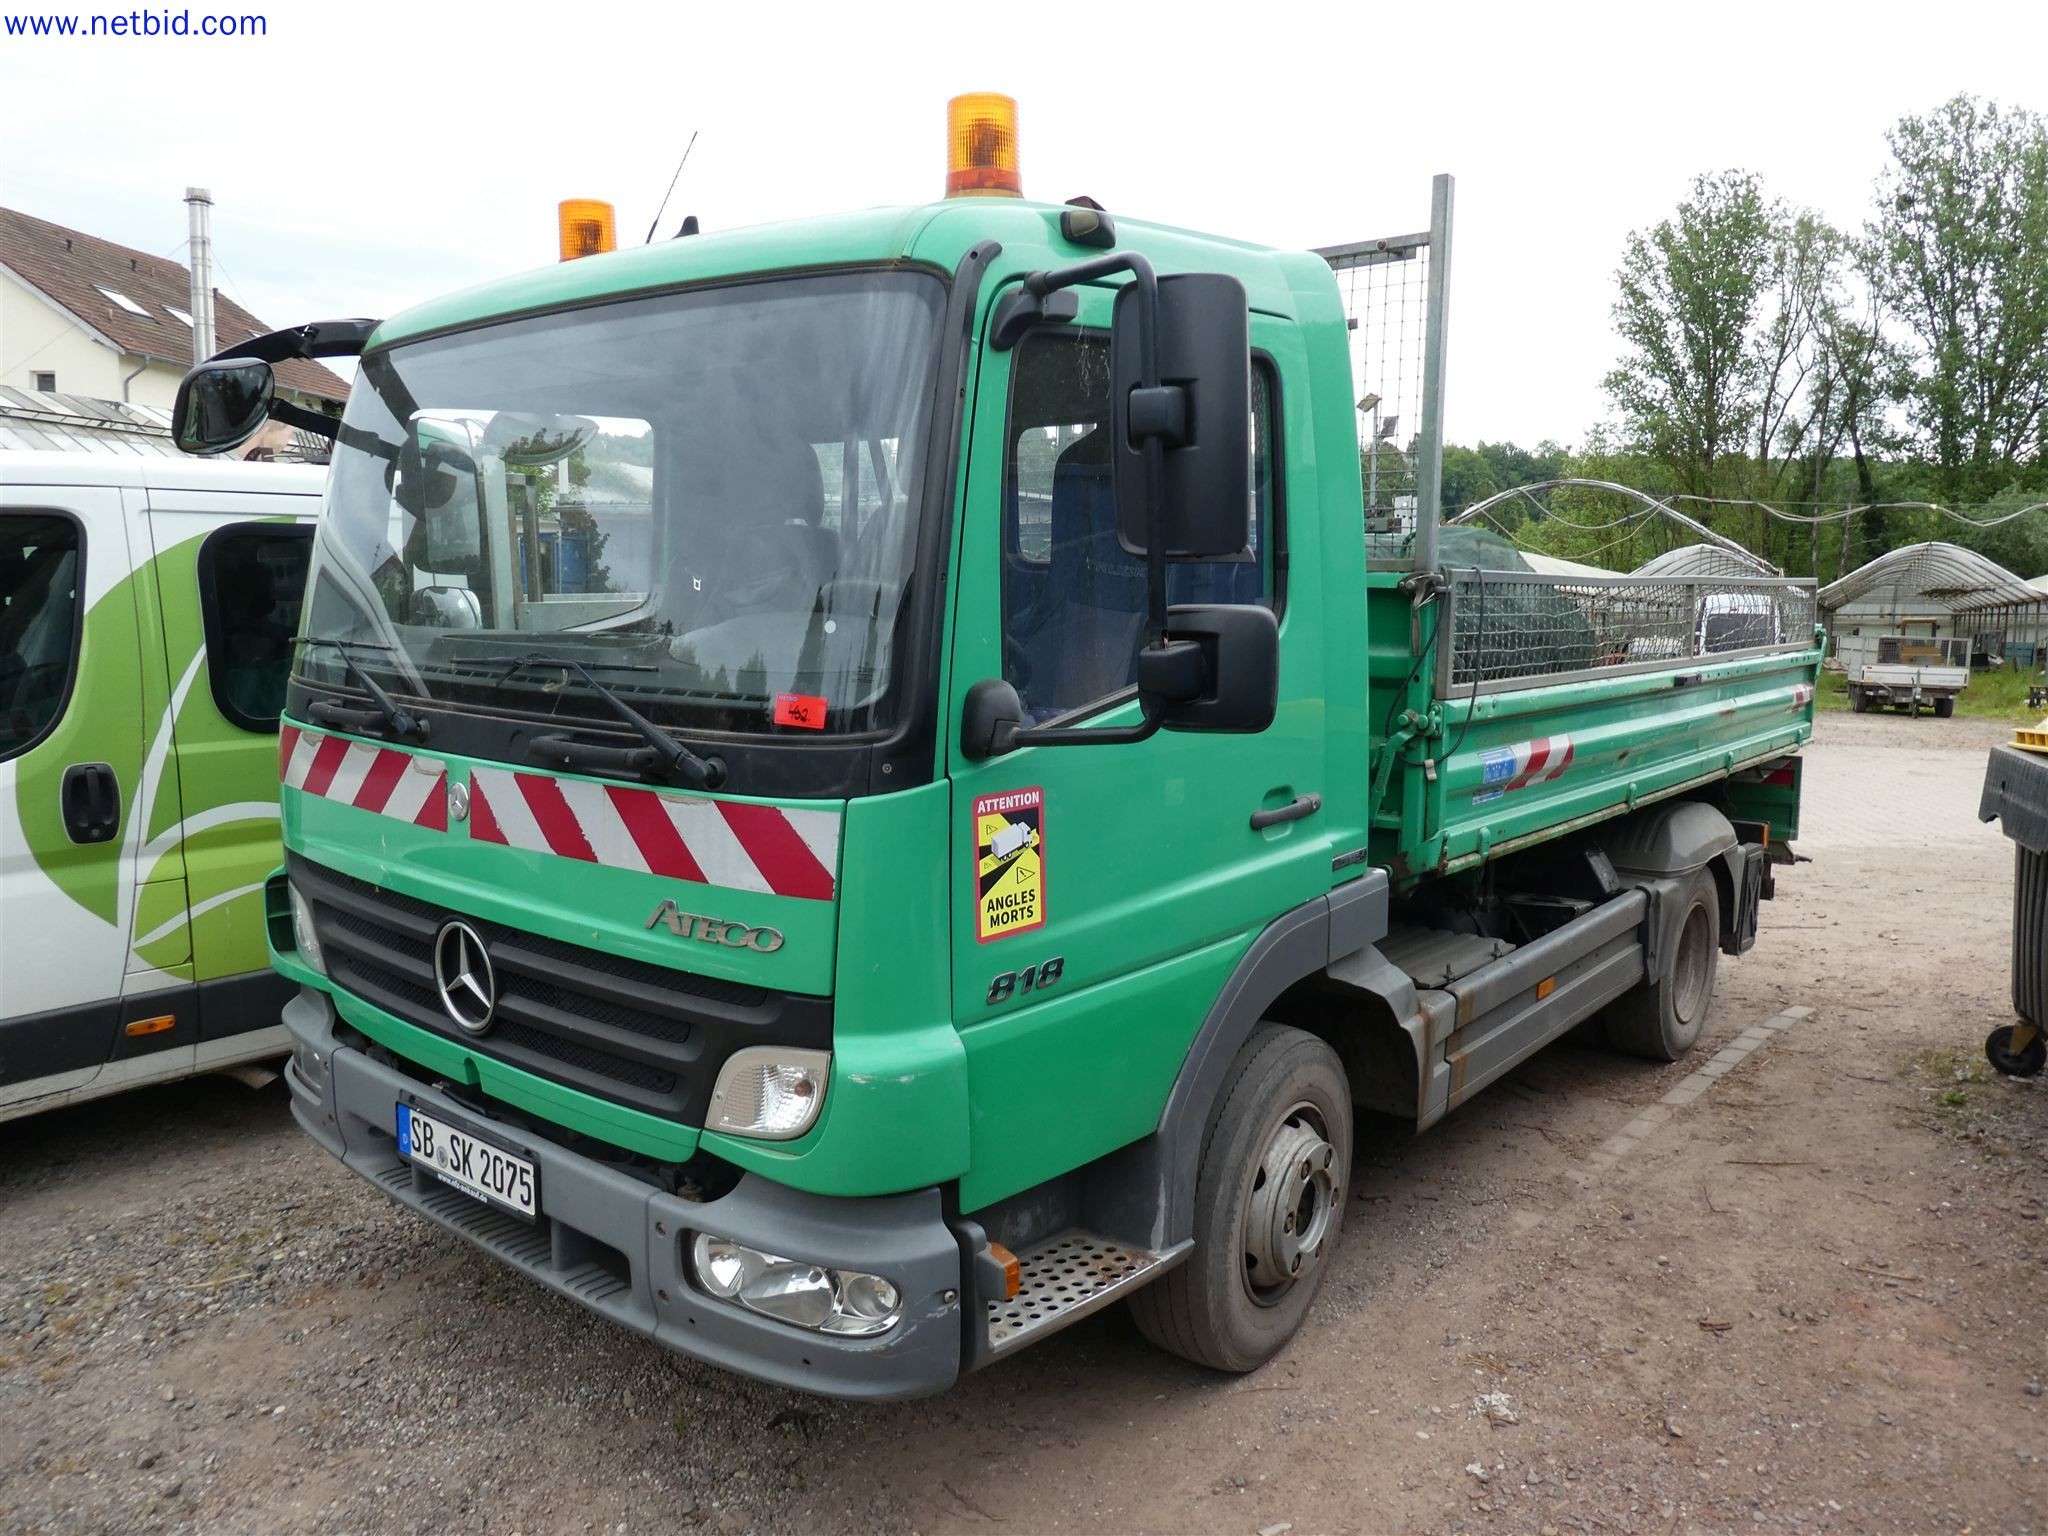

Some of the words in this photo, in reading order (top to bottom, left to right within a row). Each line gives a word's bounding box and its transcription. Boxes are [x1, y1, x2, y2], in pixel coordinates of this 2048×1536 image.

[977, 791, 1040, 814] ATTENTION
[986, 888, 1036, 913] ANGLES
[989, 905, 1034, 928] MORTS
[986, 956, 1065, 1006] 818
[411, 1116, 434, 1159] SB
[449, 1134, 474, 1180] SK
[480, 1148, 532, 1207] 2075
